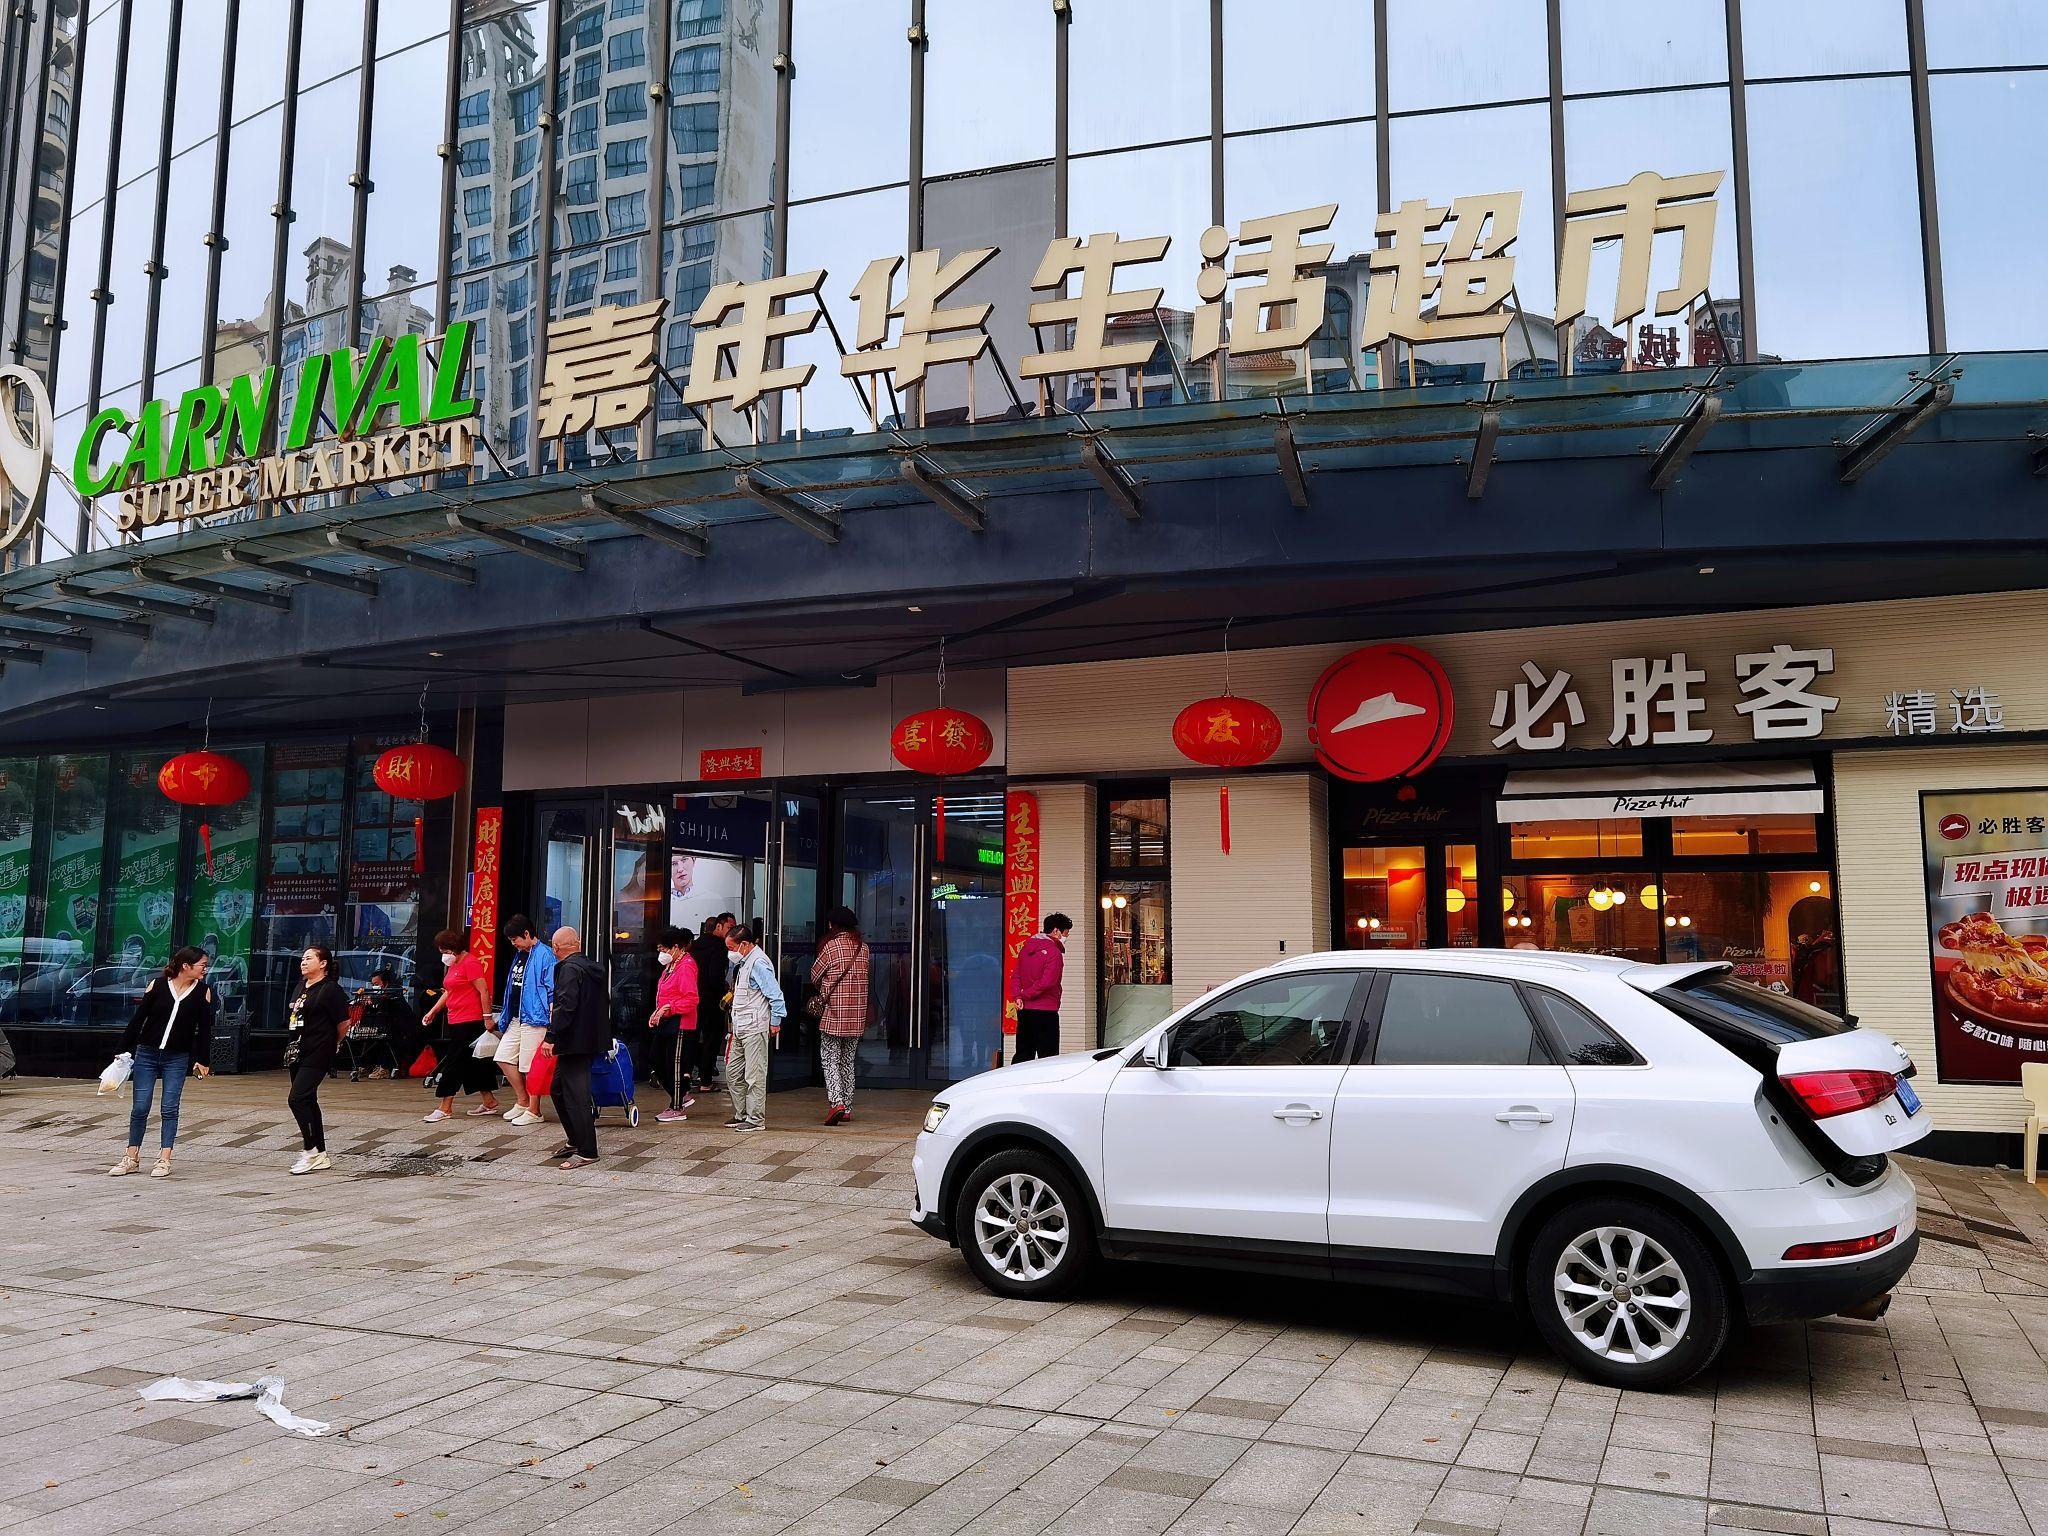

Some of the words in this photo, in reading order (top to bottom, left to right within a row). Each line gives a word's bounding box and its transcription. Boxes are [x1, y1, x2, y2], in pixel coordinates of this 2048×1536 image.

[538, 169, 1726, 440] 嘉年华生活超市
[73, 319, 481, 498] CARNIVAL
[116, 465, 252, 532] SUPER
[259, 418, 480, 503] MARKET
[1488, 644, 1840, 752] 必胜客
[1883, 686, 2006, 736] 精选
[1362, 807, 1411, 827] Pizza
[1411, 805, 1451, 823] Hut
[1613, 796, 1659, 813] Pizza
[1659, 795, 1694, 810] Hut
[679, 821, 728, 842] SHIJIA
[1978, 817, 2046, 835] 必胜客
[977, 848, 1004, 865] WELC
[1721, 946, 1754, 957] Pizza
[1960, 1019, 2014, 1049] 多款口味
[2018, 1037, 2048, 1052] 随心
